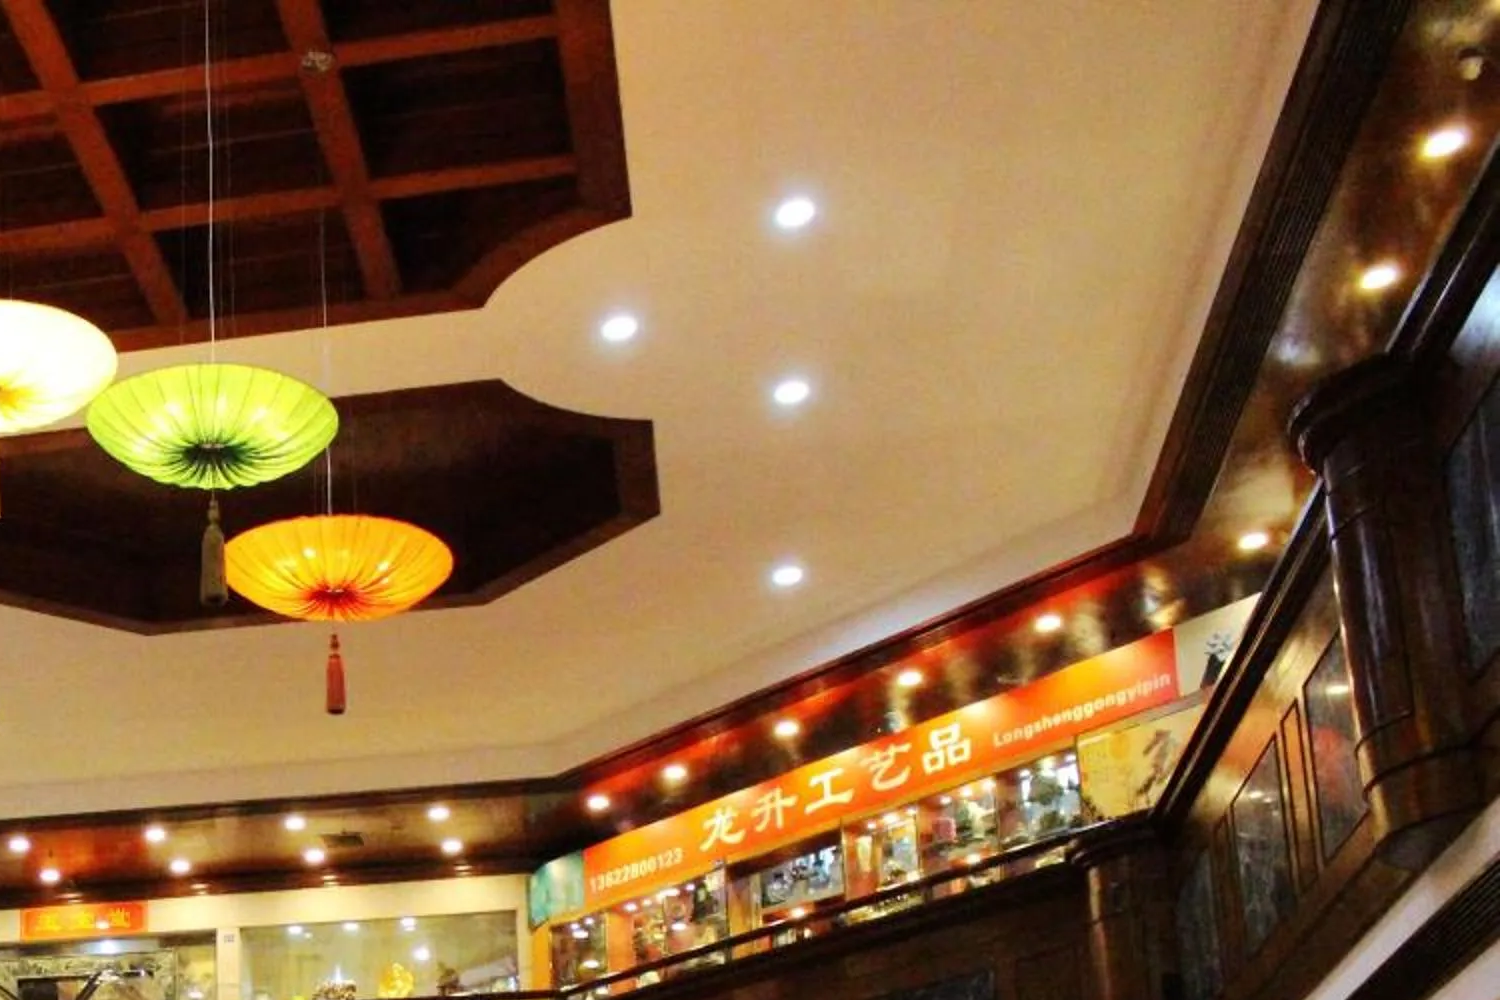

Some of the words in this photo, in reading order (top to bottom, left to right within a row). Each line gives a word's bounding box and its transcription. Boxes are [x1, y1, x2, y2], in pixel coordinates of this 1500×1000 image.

[700, 722, 972, 853] 龙升工艺品
